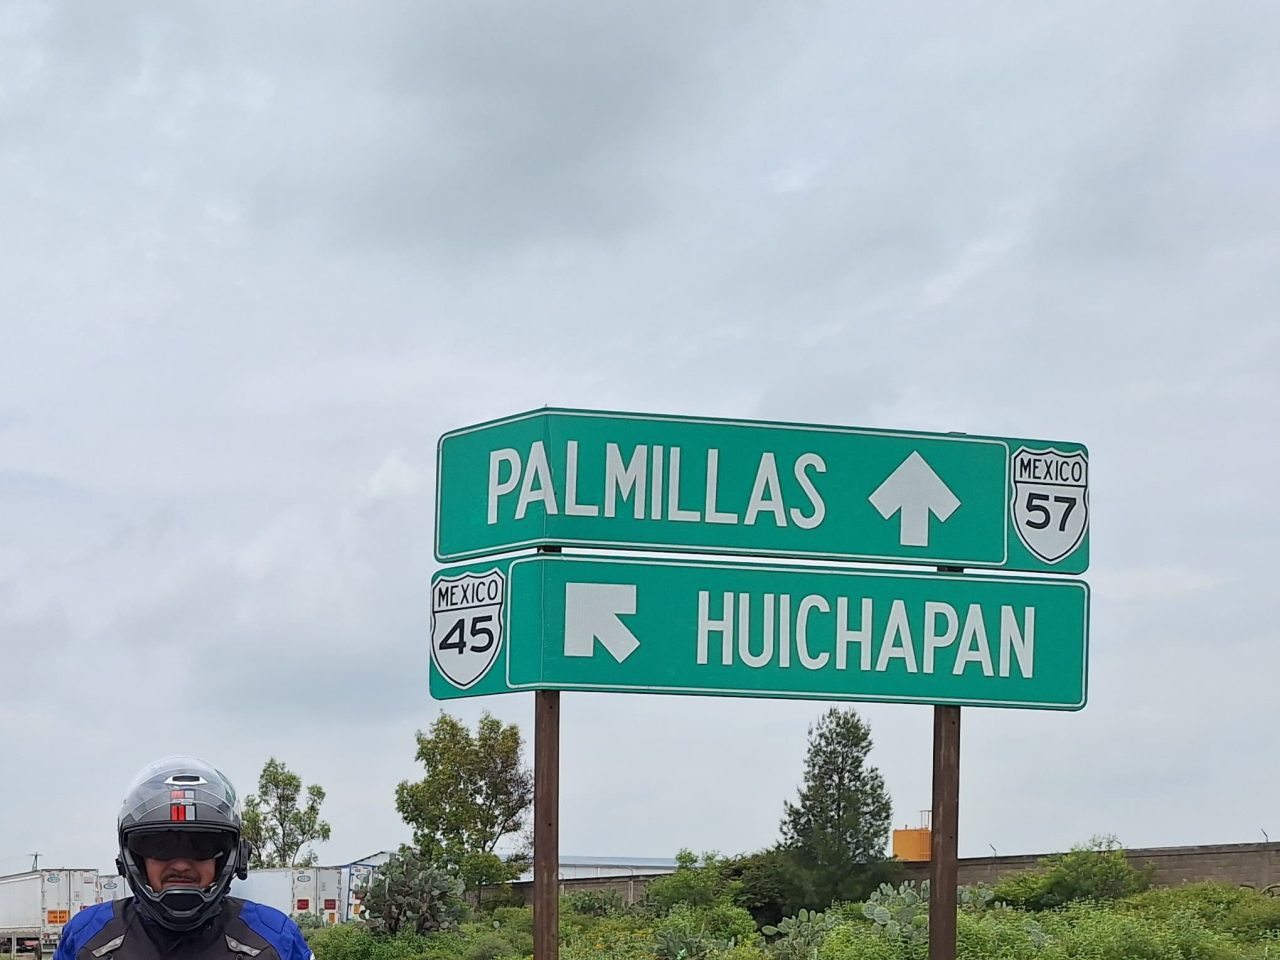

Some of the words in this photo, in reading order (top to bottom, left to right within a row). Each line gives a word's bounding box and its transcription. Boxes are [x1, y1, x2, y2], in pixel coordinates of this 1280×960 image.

[487, 439, 827, 530] PALMILLAS
[1020, 457, 1082, 482] MEXICO
[1025, 492, 1077, 532] 57
[438, 579, 498, 608] MEXICO
[439, 615, 494, 655] 45
[696, 590, 1036, 679] HUICHAPAN
